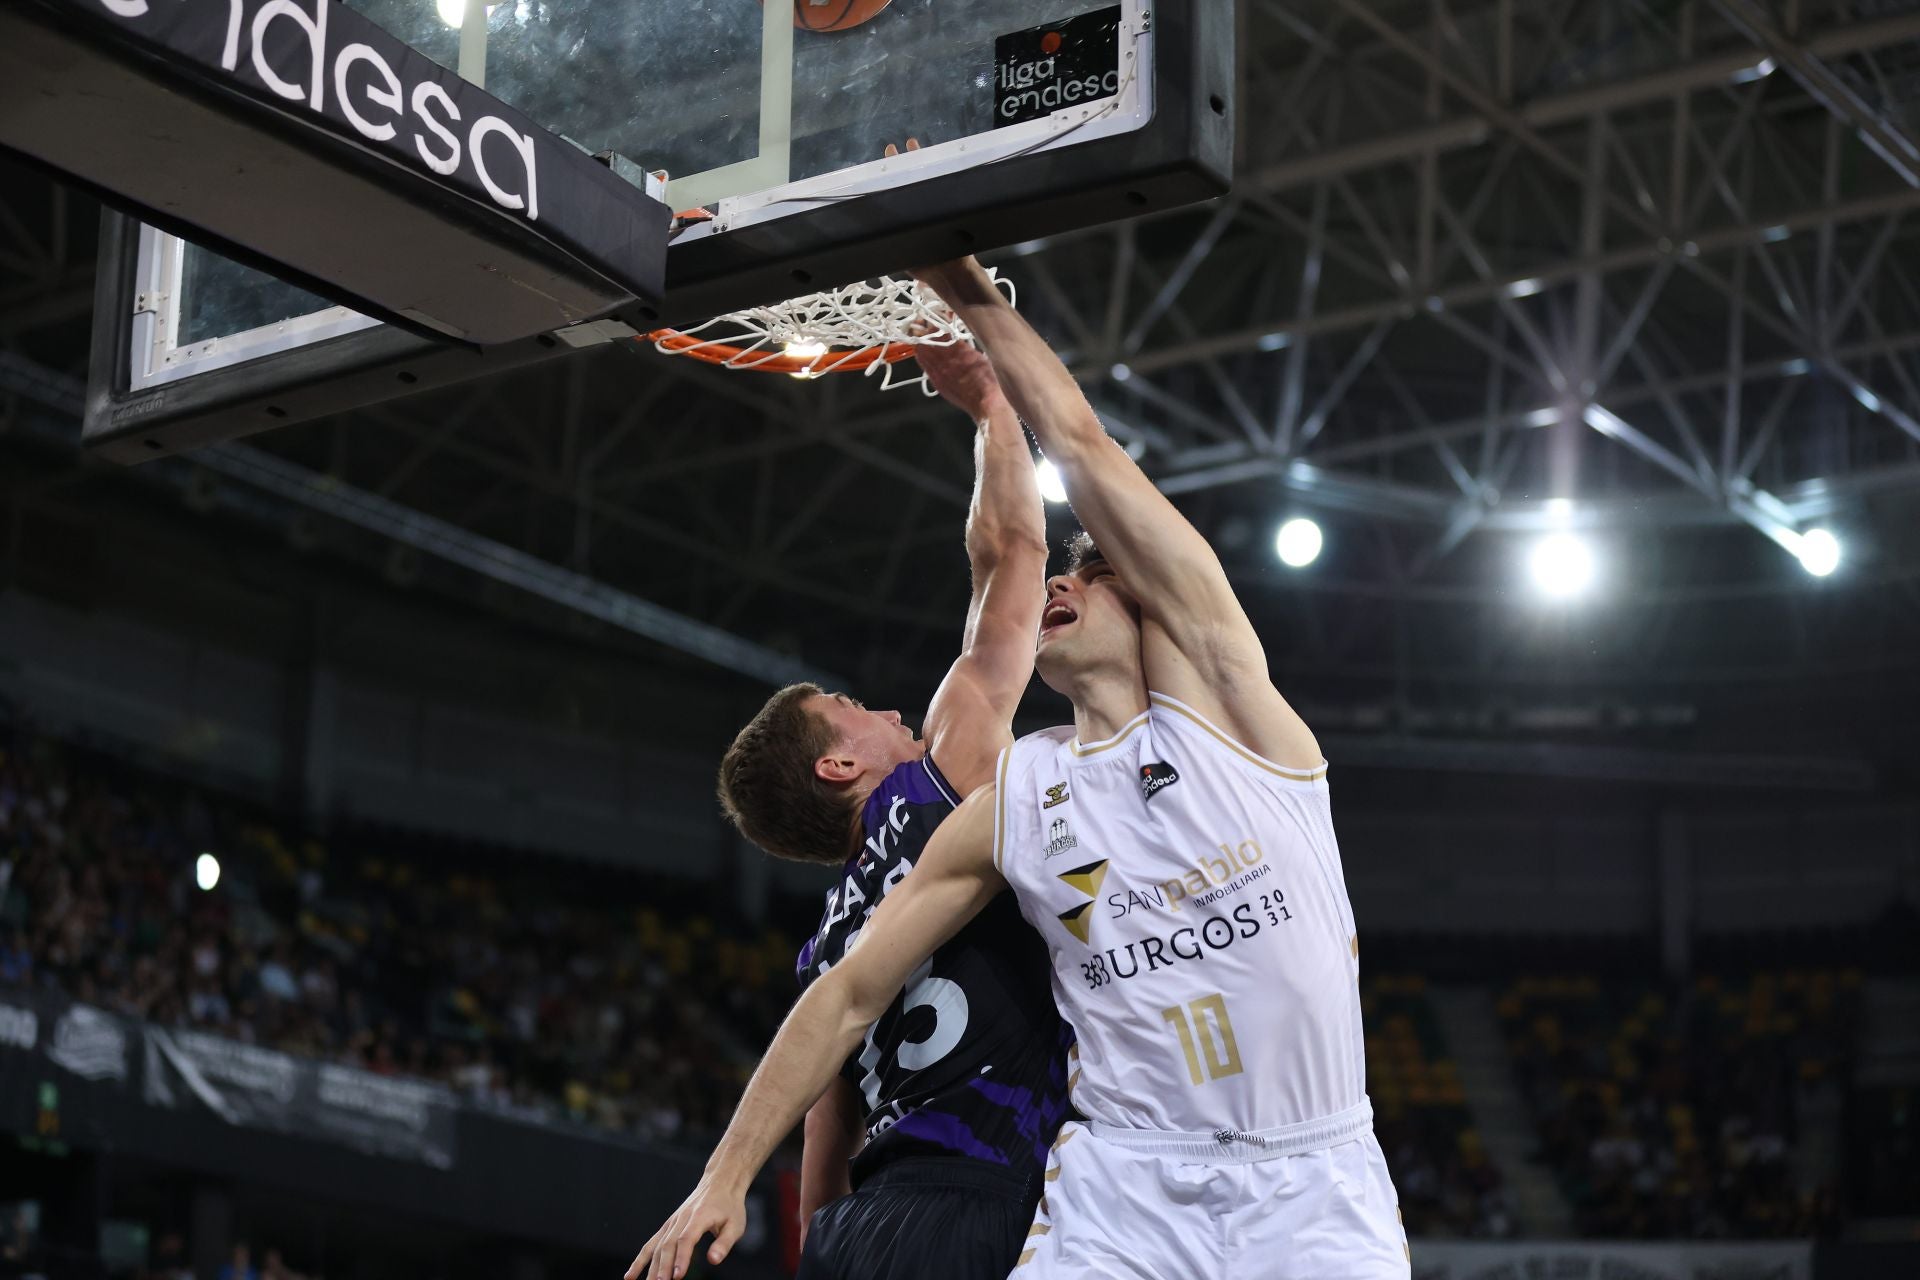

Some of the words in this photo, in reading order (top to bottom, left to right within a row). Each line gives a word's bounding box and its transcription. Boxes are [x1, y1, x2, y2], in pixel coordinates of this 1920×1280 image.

[1001, 57, 1055, 90] liga
[101, 0, 537, 220] desa
[1192, 863, 1272, 909] INMOBILIARIA
[1259, 888, 1284, 910] 20
[1266, 905, 1292, 927] 31
[1161, 992, 1244, 1087] 10
